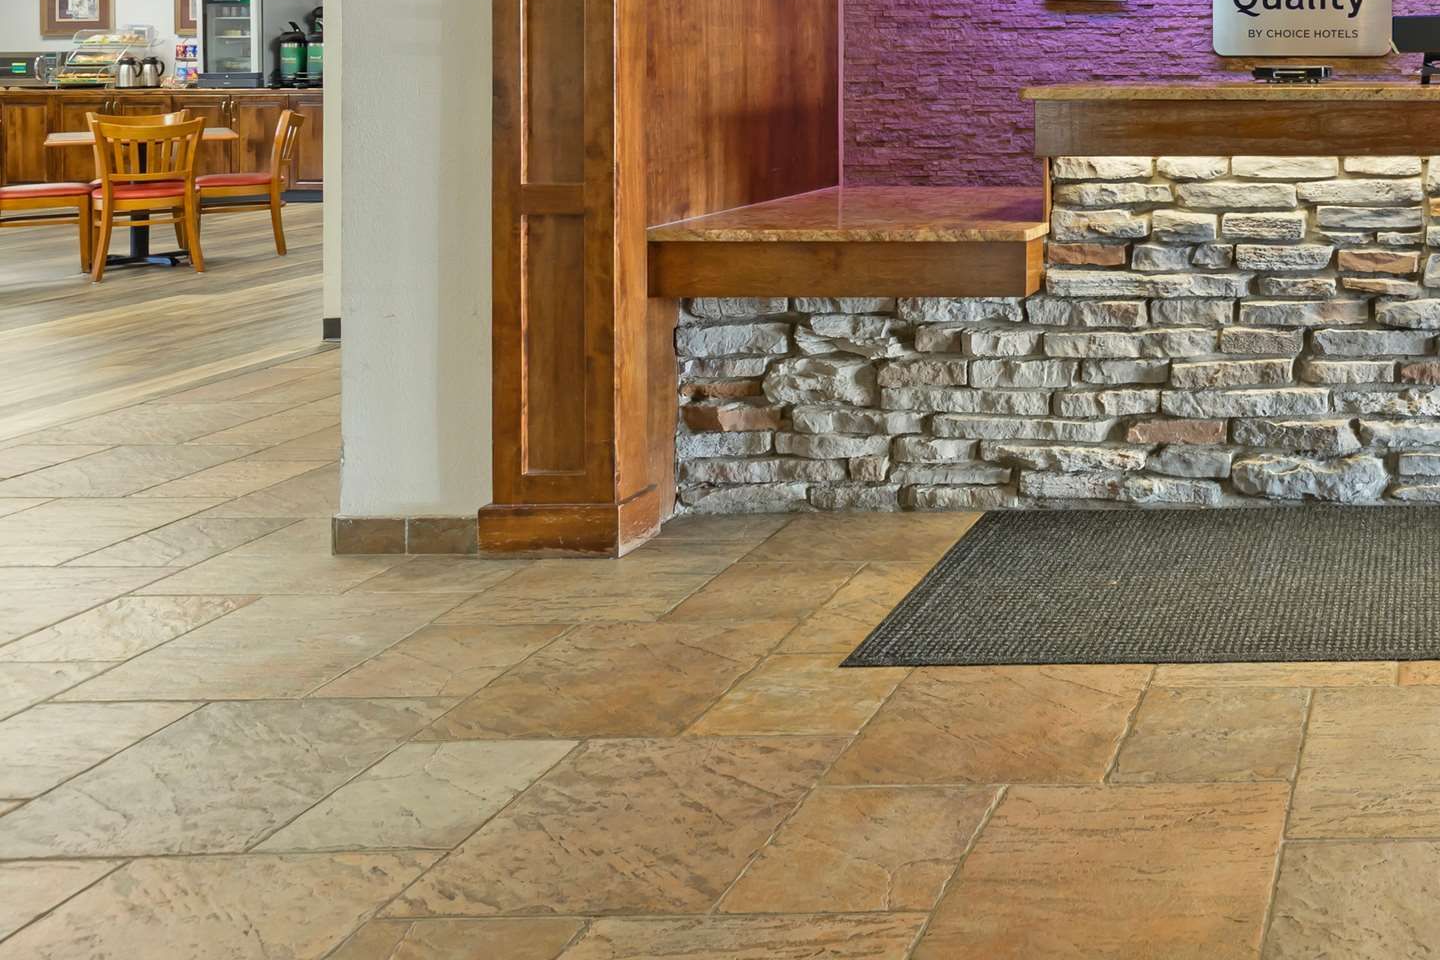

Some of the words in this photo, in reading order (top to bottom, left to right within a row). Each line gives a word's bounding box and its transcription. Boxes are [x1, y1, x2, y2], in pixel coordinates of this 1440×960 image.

[1248, 29, 1263, 39] BY
[1266, 29, 1310, 39] CHOICE
[1314, 29, 1359, 39] HOTELS
